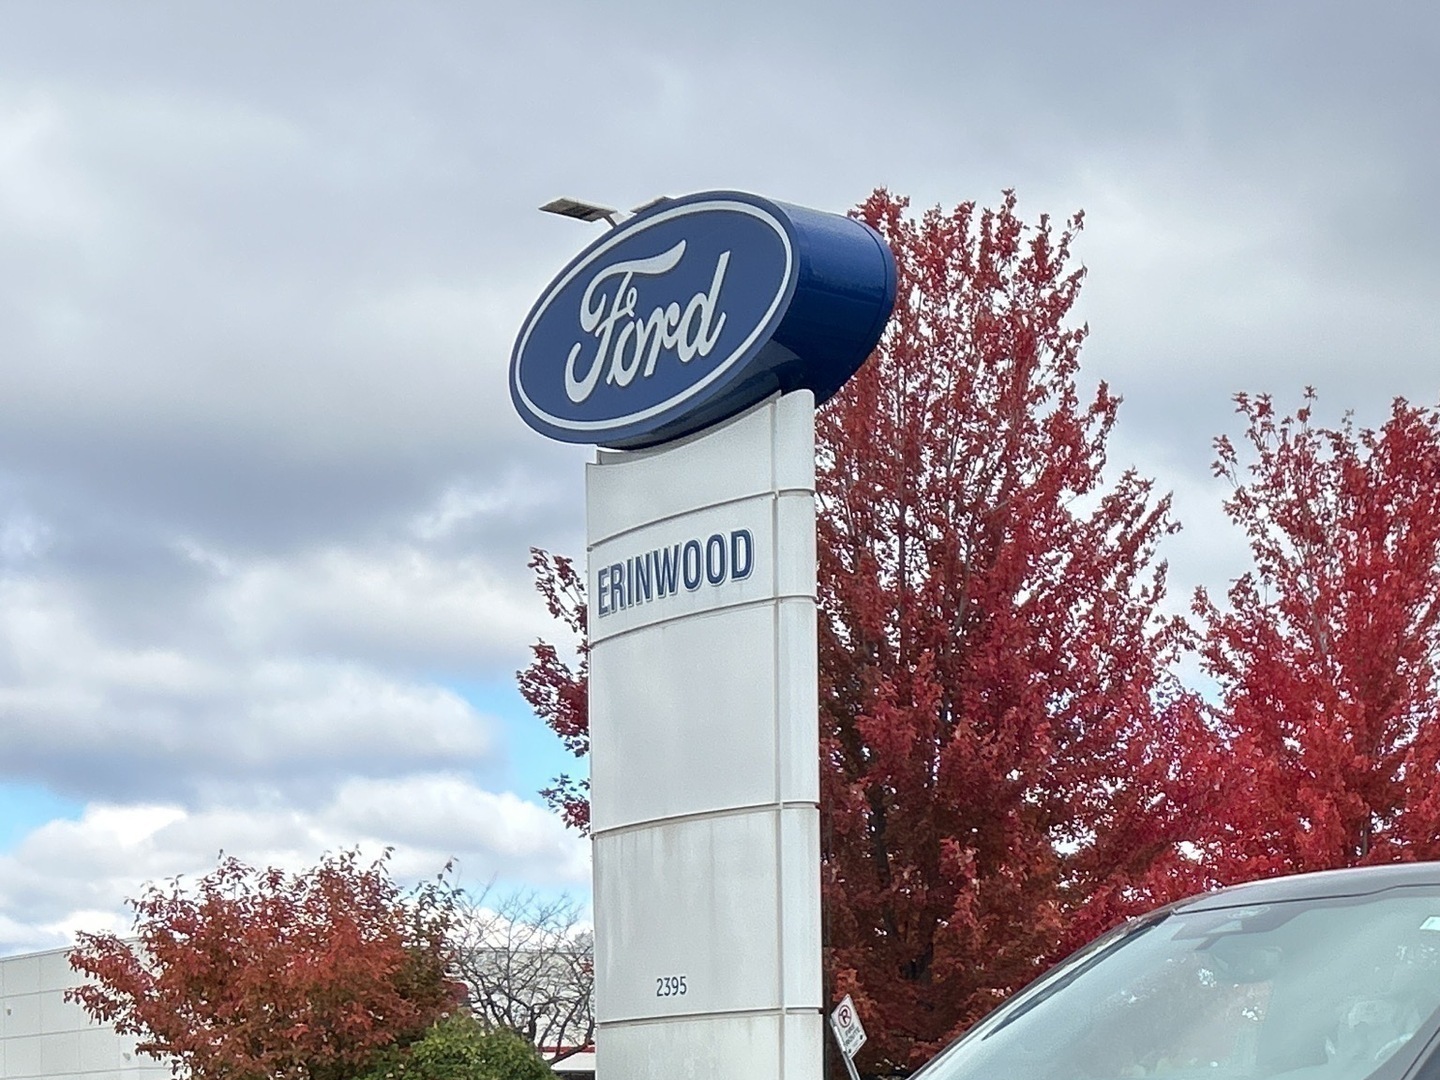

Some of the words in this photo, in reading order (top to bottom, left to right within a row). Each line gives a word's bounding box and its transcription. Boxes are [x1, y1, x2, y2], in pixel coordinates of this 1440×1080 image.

[564, 239, 730, 402] Ford
[597, 528, 755, 617] ERINWOOD
[656, 976, 687, 997] 2395
